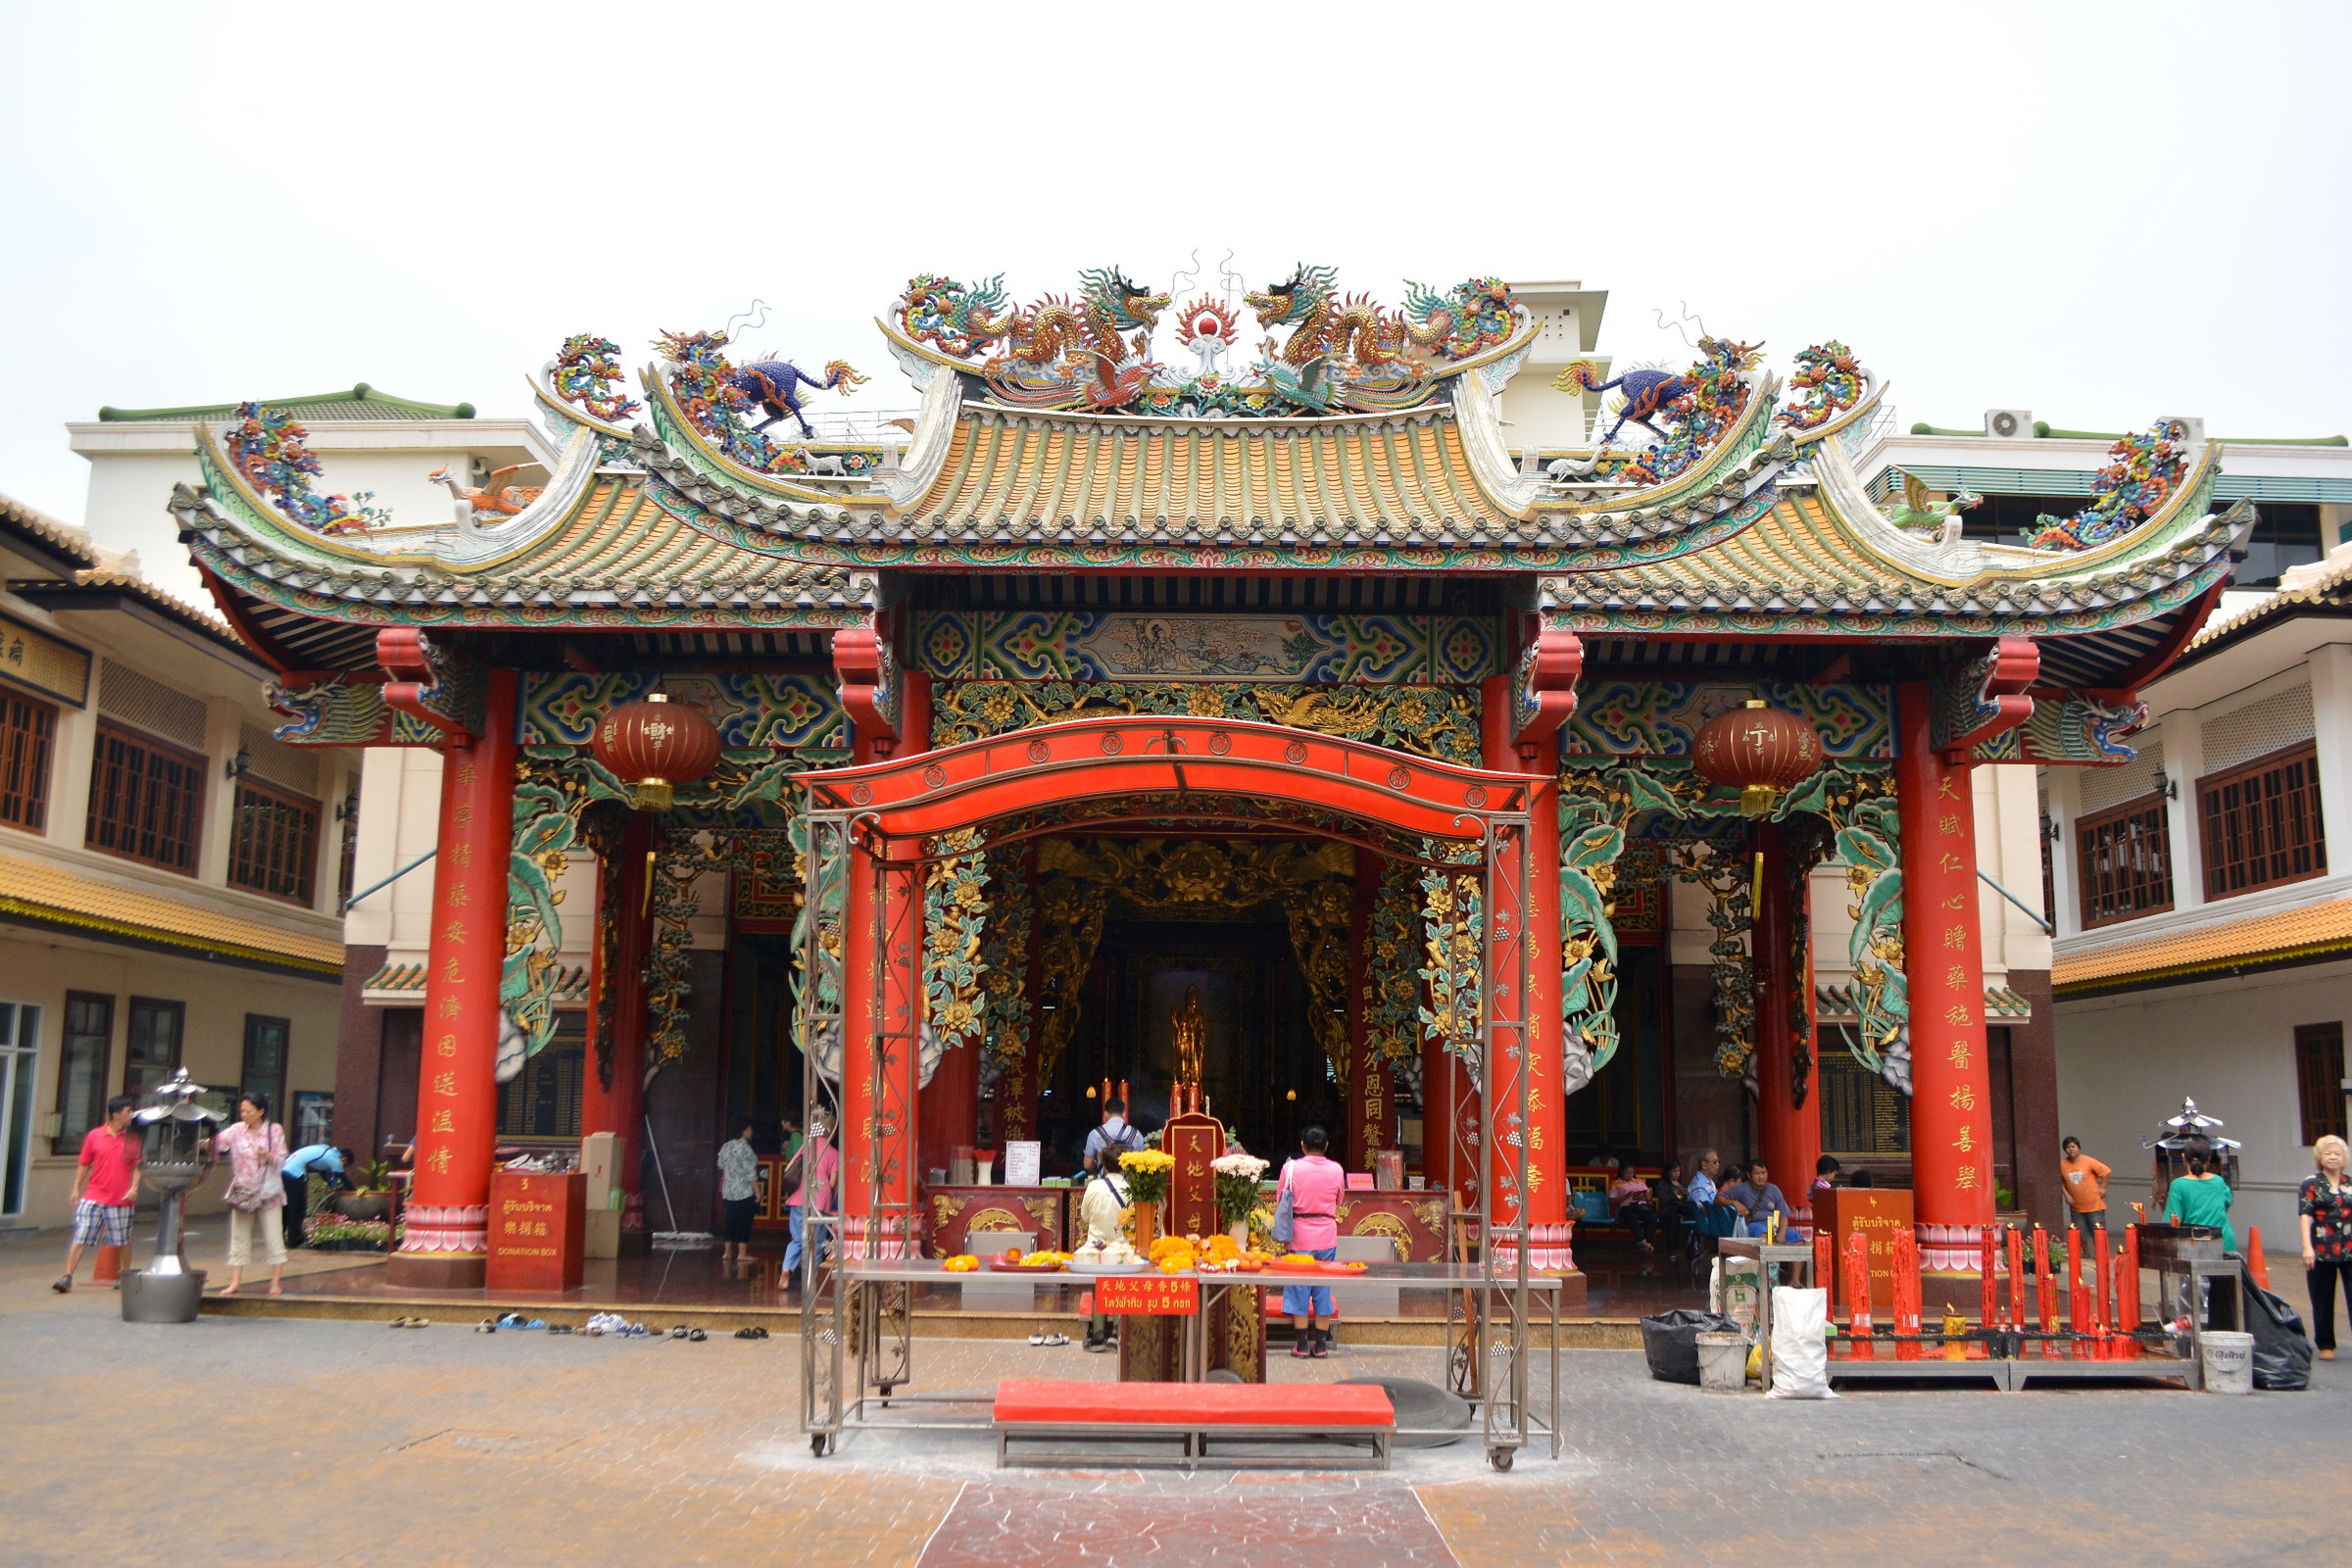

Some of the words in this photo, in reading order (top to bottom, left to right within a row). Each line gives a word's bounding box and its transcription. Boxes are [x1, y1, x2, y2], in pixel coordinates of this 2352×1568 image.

[1187, 1134, 1205, 1233] 天地父母
[503, 1199, 553, 1215] ตู้รับบริจาค
[1852, 1215, 1901, 1231] ตู้รับบริจาค
[498, 1248, 539, 1256] DONATION
[1102, 1280, 1191, 1294] 天地父母香5條
[1147, 1298, 1157, 1312] ธูป
[1161, 1297, 1170, 1308] 5
[1173, 1299, 1191, 1308] ดอก
